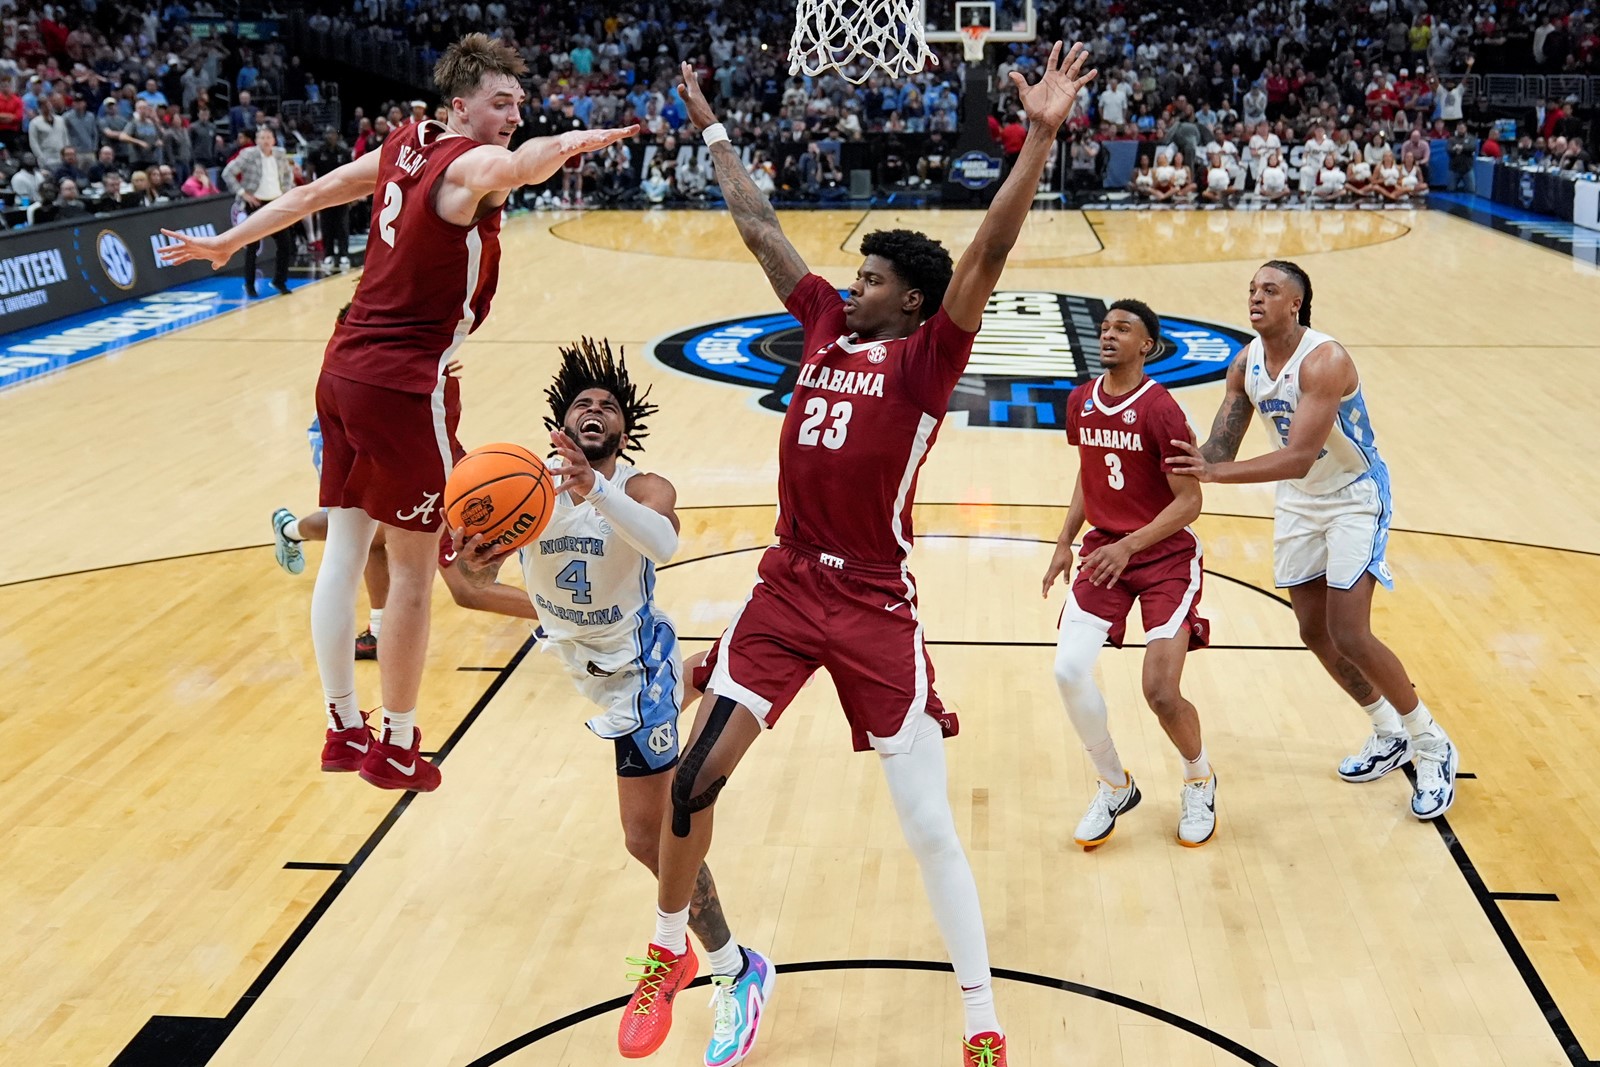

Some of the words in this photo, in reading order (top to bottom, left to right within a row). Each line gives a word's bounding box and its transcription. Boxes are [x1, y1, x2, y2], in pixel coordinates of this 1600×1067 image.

[395, 145, 427, 176] NELN
[379, 181, 402, 248] 2
[0, 248, 68, 295] SIXTEEN
[100, 233, 134, 285] SEC
[696, 337, 750, 365] SWEET
[868, 347, 886, 361] SEC
[796, 363, 885, 398] ALABAMA
[798, 397, 853, 450] 23
[1121, 410, 1138, 423] SEC
[1079, 427, 1143, 451] ALABAMA
[1104, 452, 1125, 490] 3
[540, 536, 604, 557] NORTH
[820, 553, 845, 569] RTR
[555, 560, 592, 604] 4
[535, 594, 623, 626] CAROLINA
